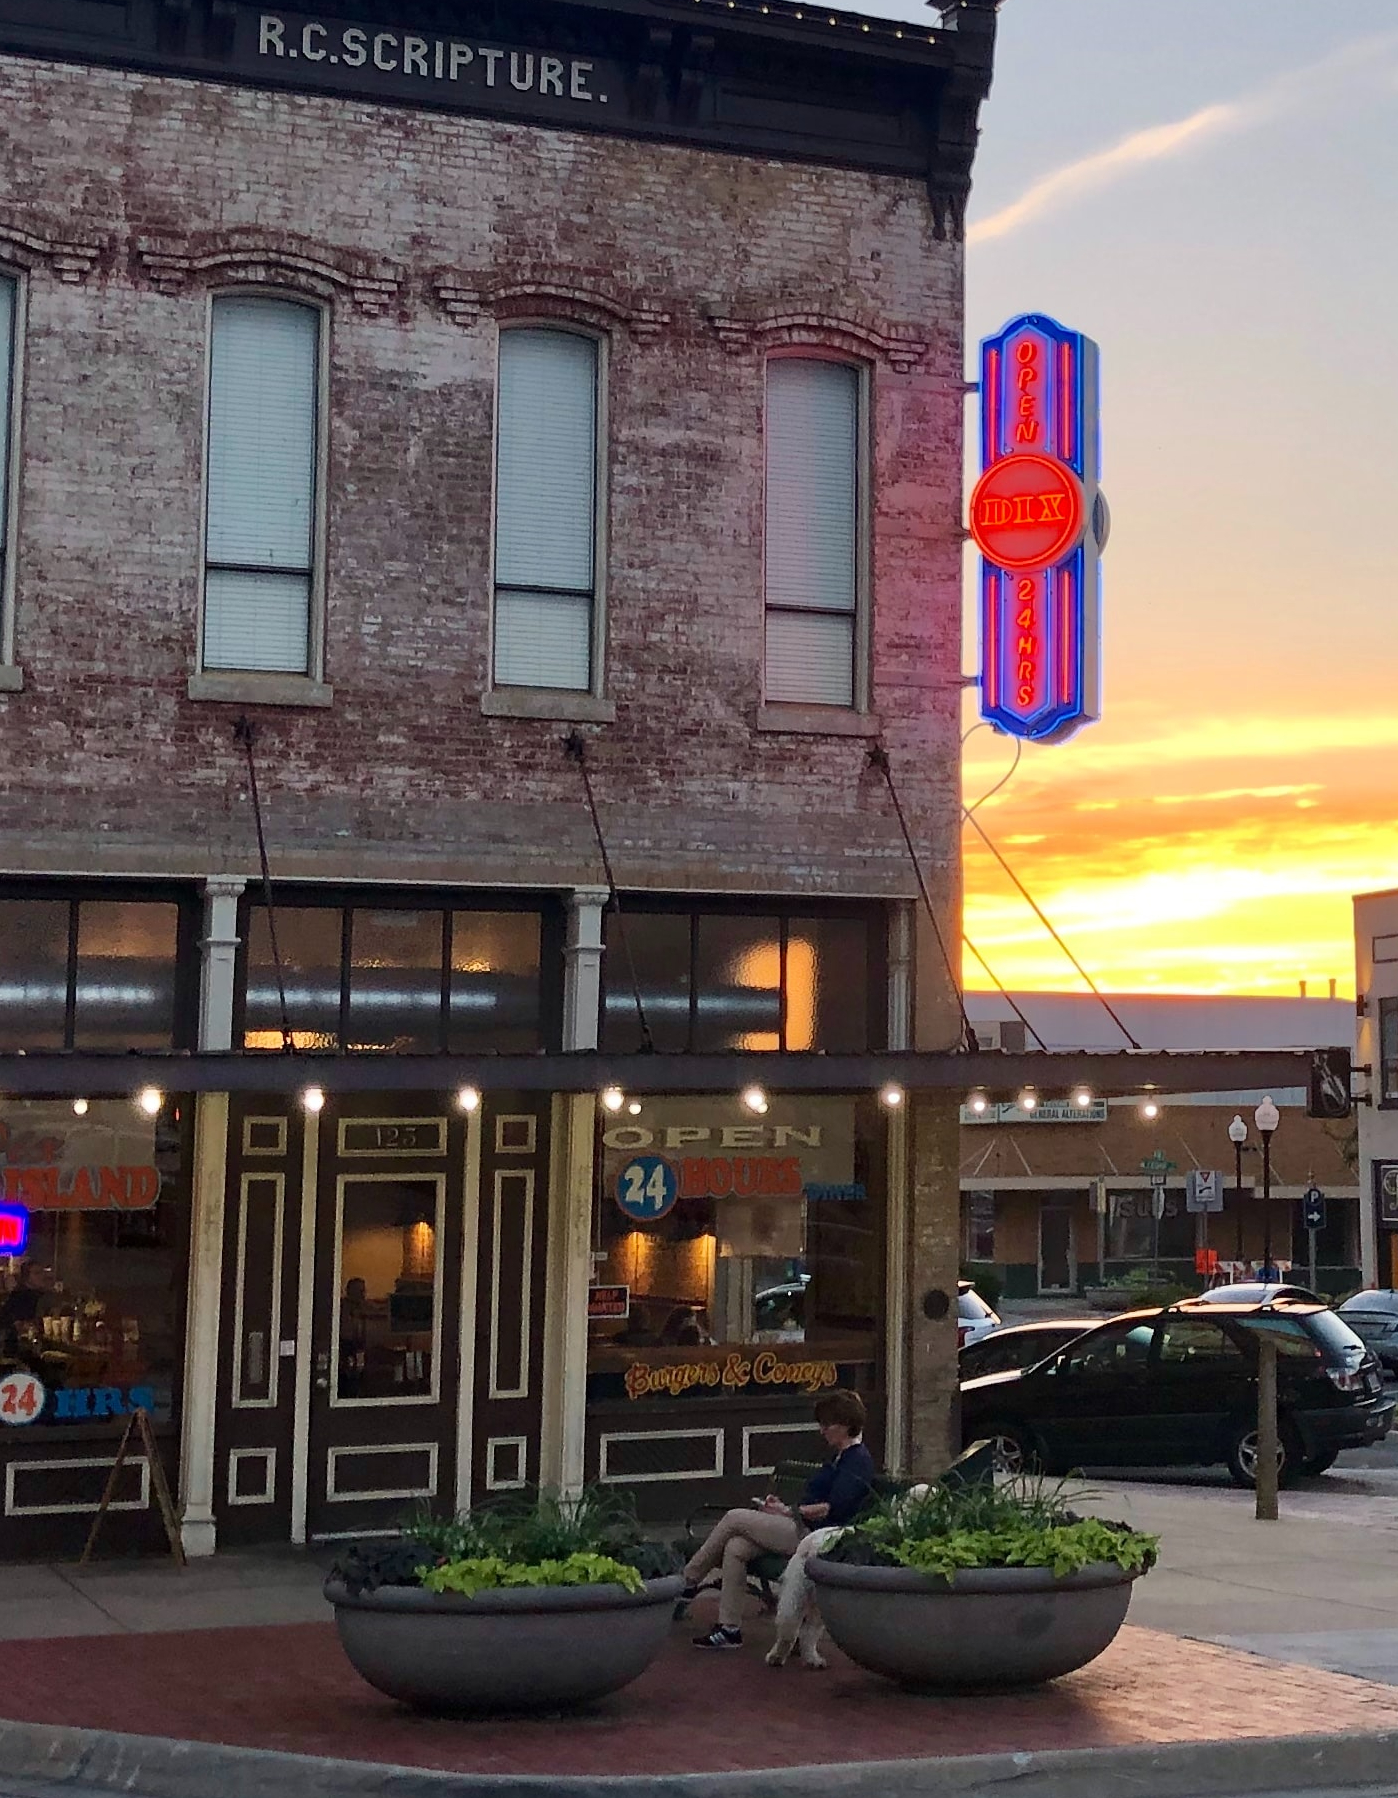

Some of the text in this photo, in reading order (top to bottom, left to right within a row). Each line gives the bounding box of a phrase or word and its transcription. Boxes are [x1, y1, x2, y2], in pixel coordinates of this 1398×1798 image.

[1016, 341, 1038, 443] OPEN
[377, 1127, 416, 1147] 123
[602, 1125, 822, 1149] OPEN
[3, 1165, 160, 1208] ISLAND
[624, 1156, 802, 1211] 24 HOURS
[1310, 1190, 1319, 1203] P
[624, 1351, 838, 1400] Burgers & Coneys
[0, 1382, 156, 1418] 24 HRS
